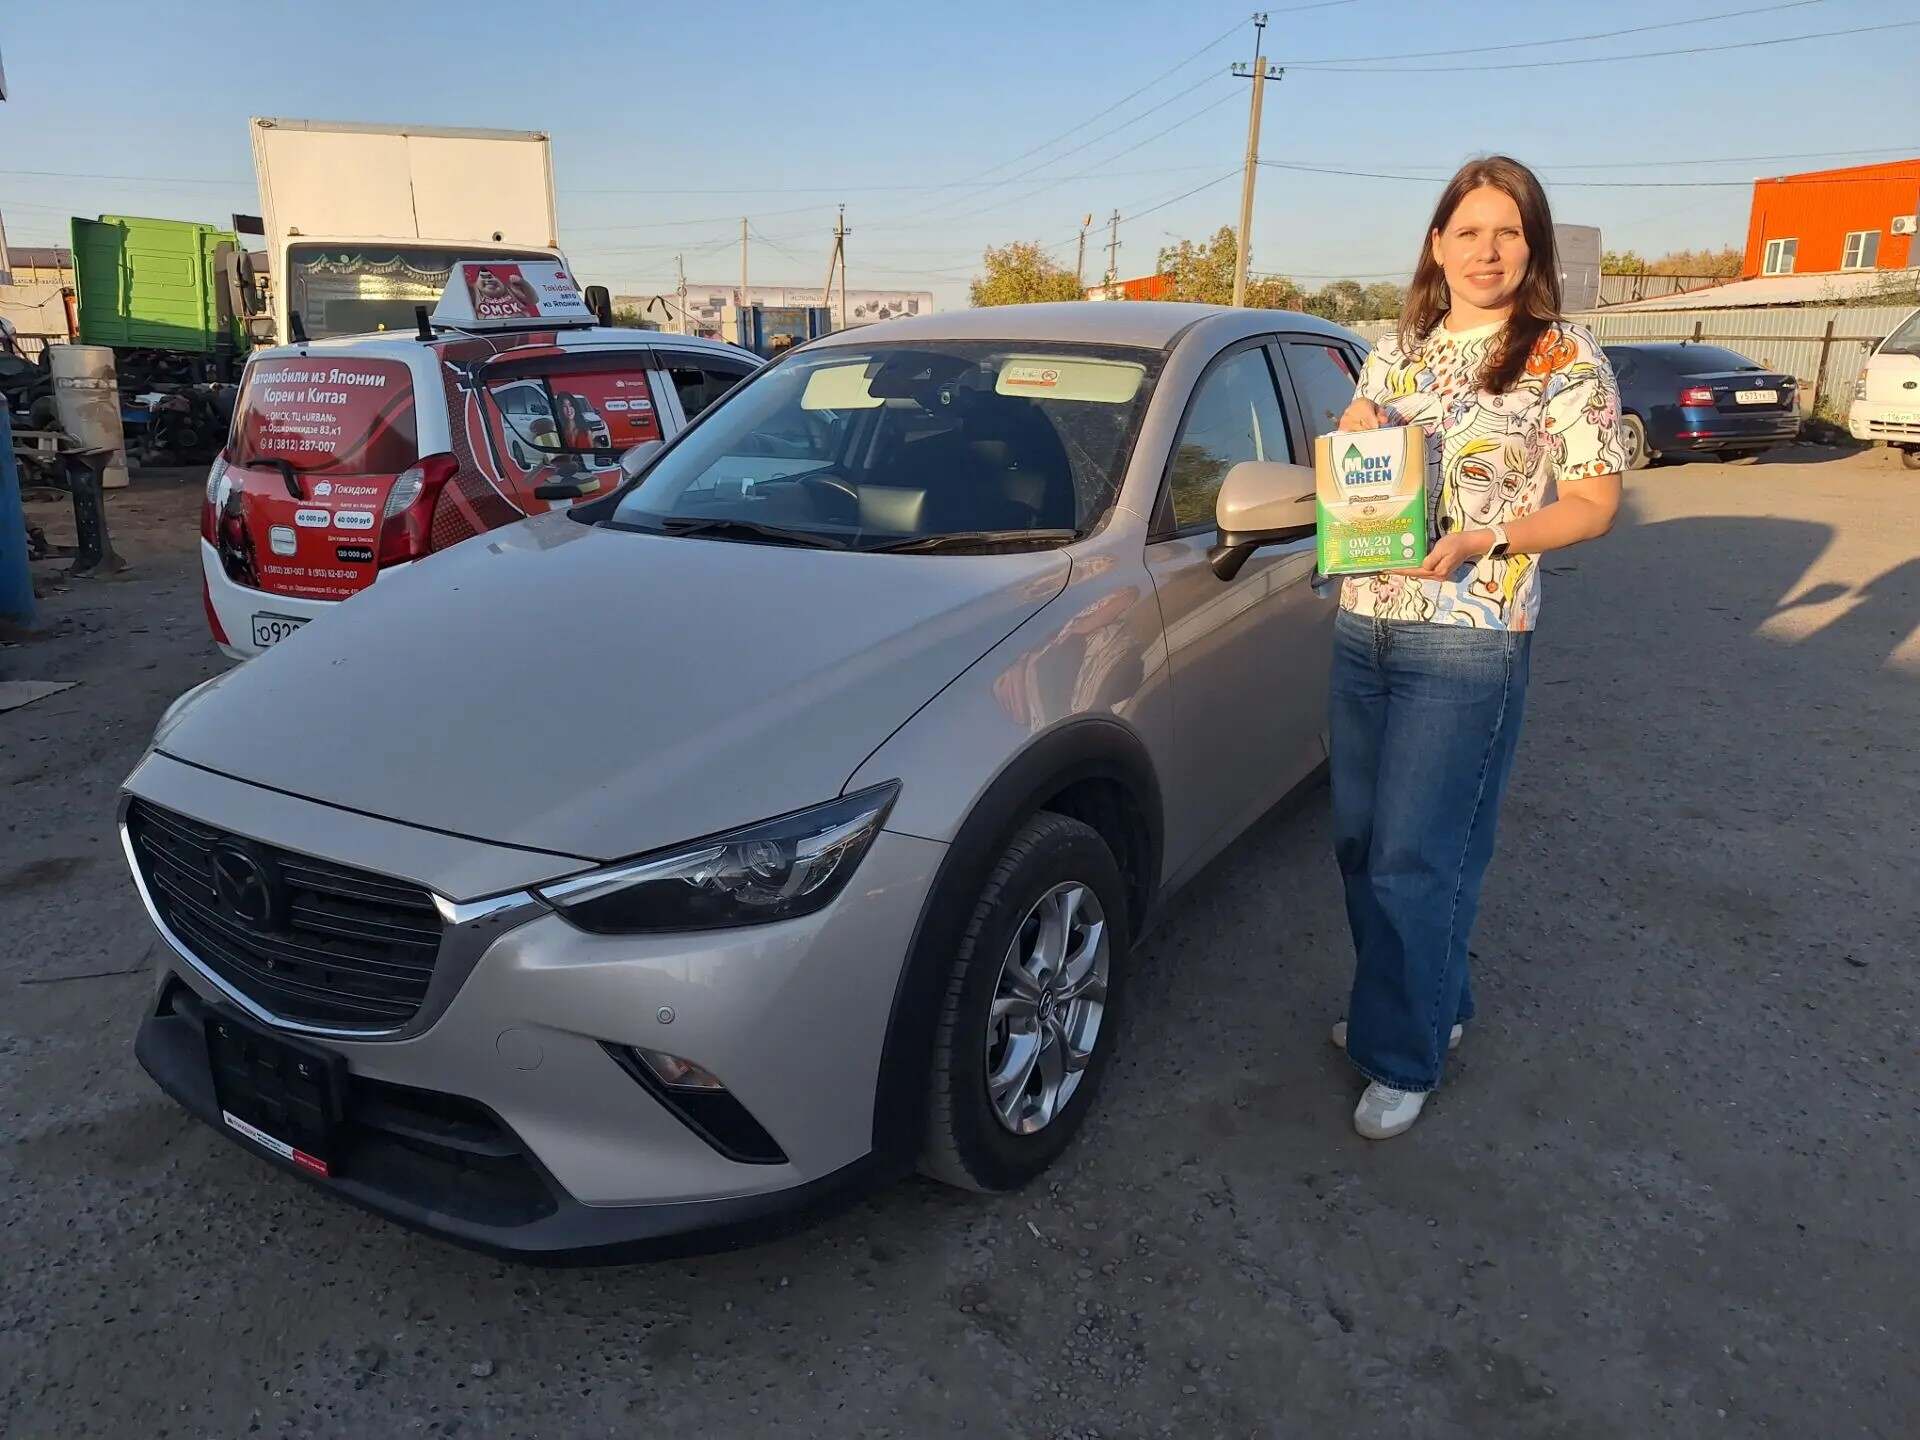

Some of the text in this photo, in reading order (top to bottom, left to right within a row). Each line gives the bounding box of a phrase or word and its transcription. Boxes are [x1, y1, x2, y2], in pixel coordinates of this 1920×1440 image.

[479, 302, 522, 315] ОМСК
[311, 371, 327, 384] из
[328, 368, 386, 387] Японии
[263, 387, 347, 406] Кореи и Китая
[291, 412, 301, 423] ТЦ
[268, 438, 336, 453] 8 (3812) 287-007
[1344, 455, 1392, 473] MOLY
[1345, 469, 1392, 485] GREEN
[334, 483, 378, 497] Токидоки
